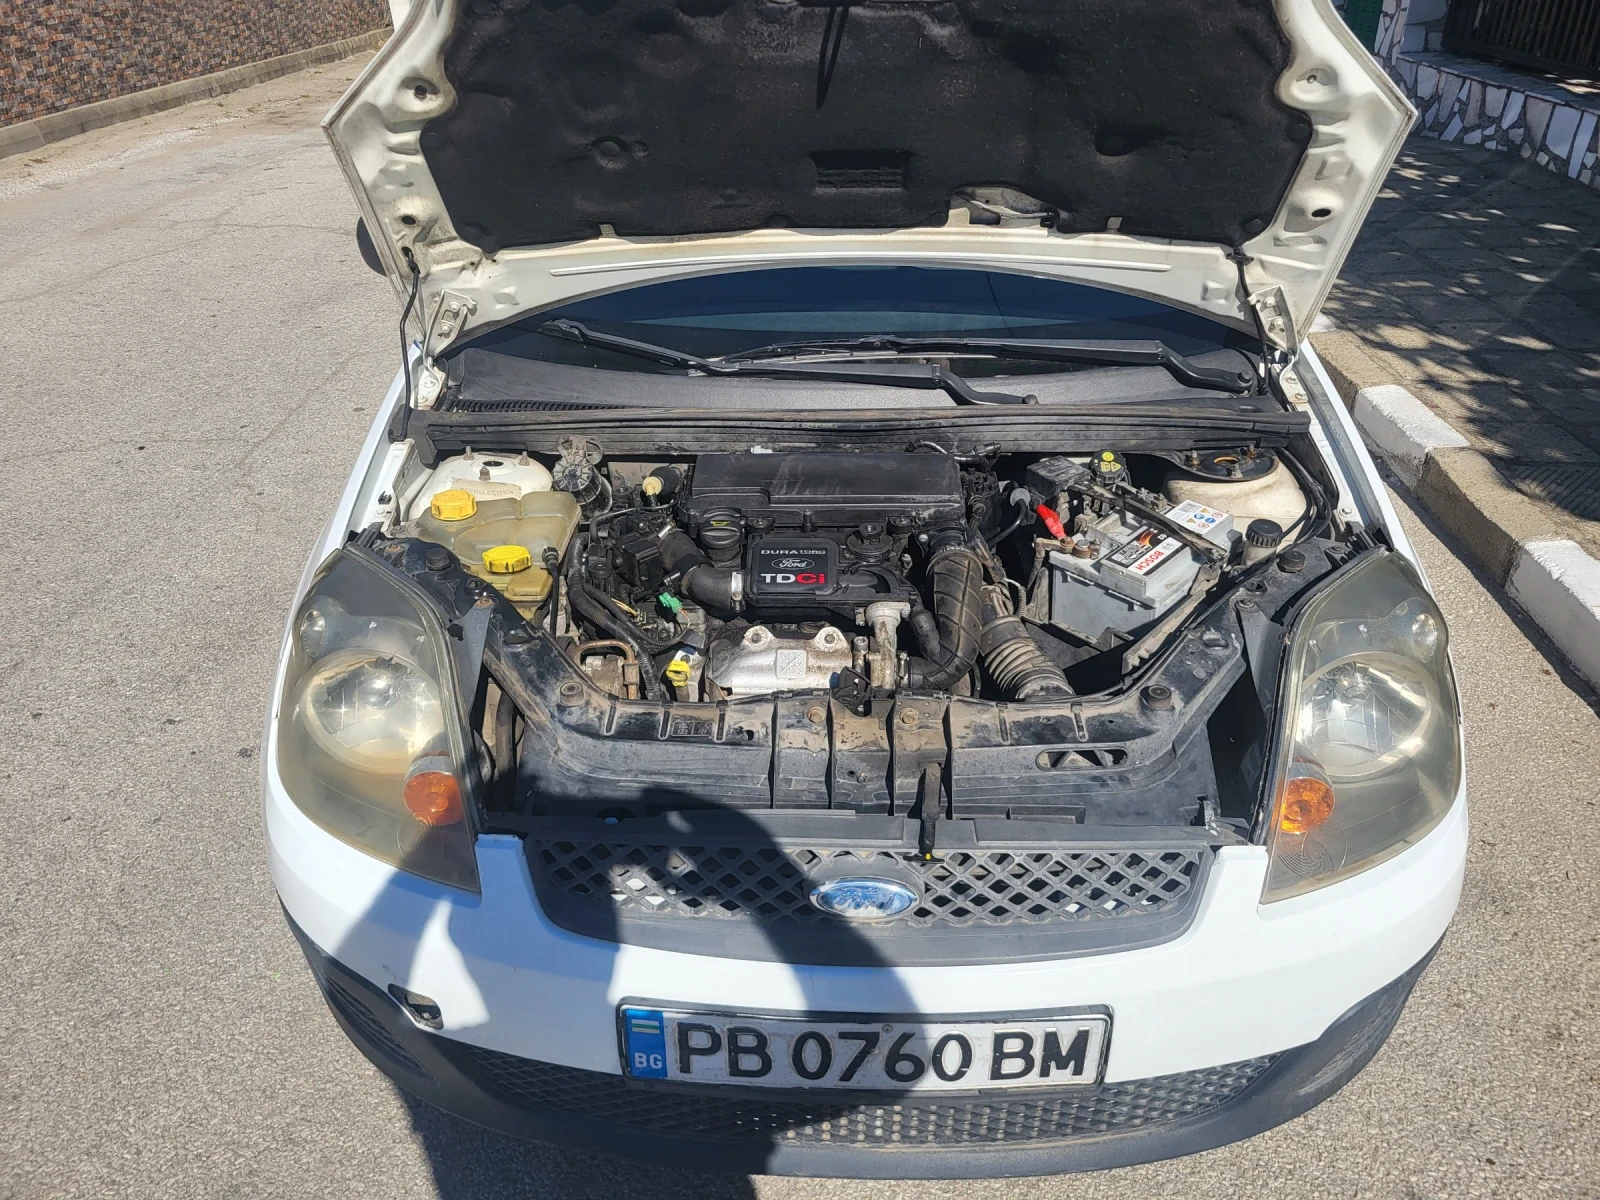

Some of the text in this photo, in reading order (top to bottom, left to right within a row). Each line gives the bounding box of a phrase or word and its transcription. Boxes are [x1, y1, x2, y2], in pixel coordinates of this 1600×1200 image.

[779, 559, 808, 568] Ford
[1135, 550, 1164, 571] BOSCH
[761, 573, 825, 584] TDCi
[634, 1052, 662, 1069] BG
[676, 1021, 1091, 1083] PB 0760 BM
